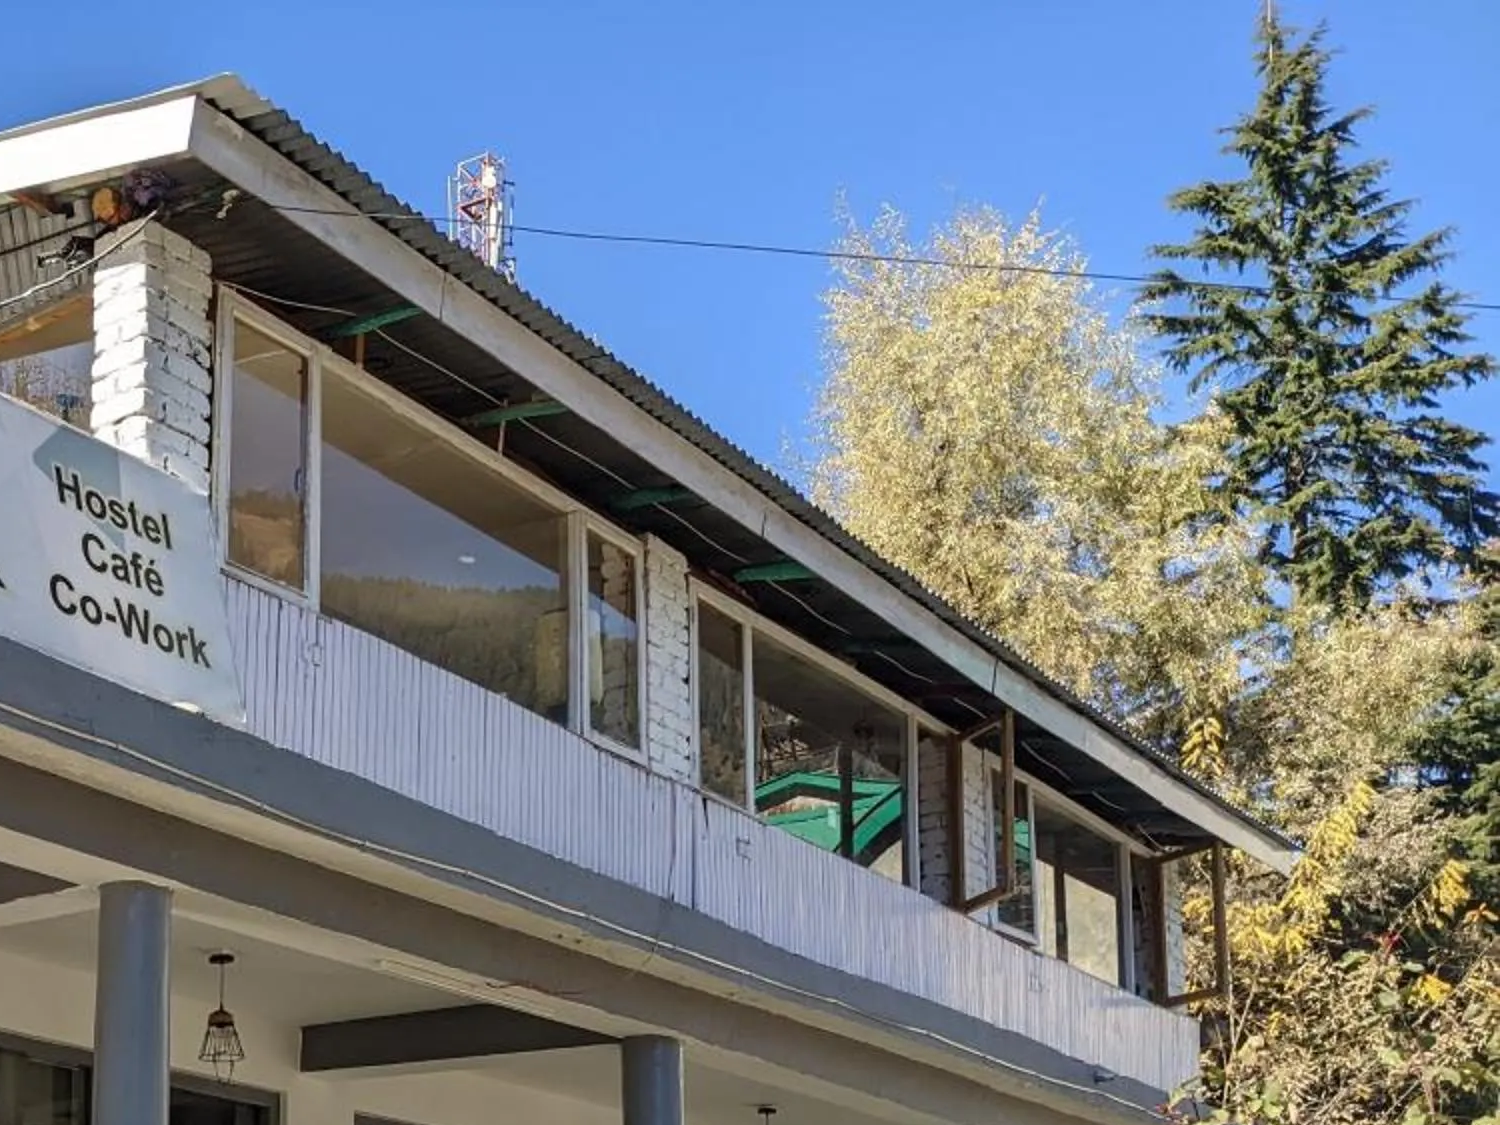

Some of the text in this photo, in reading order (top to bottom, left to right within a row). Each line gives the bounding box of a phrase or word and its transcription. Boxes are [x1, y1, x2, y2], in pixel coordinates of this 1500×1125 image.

[54, 465, 173, 550] Hostel
[81, 532, 164, 597] Café
[49, 573, 212, 669] Co-Work
